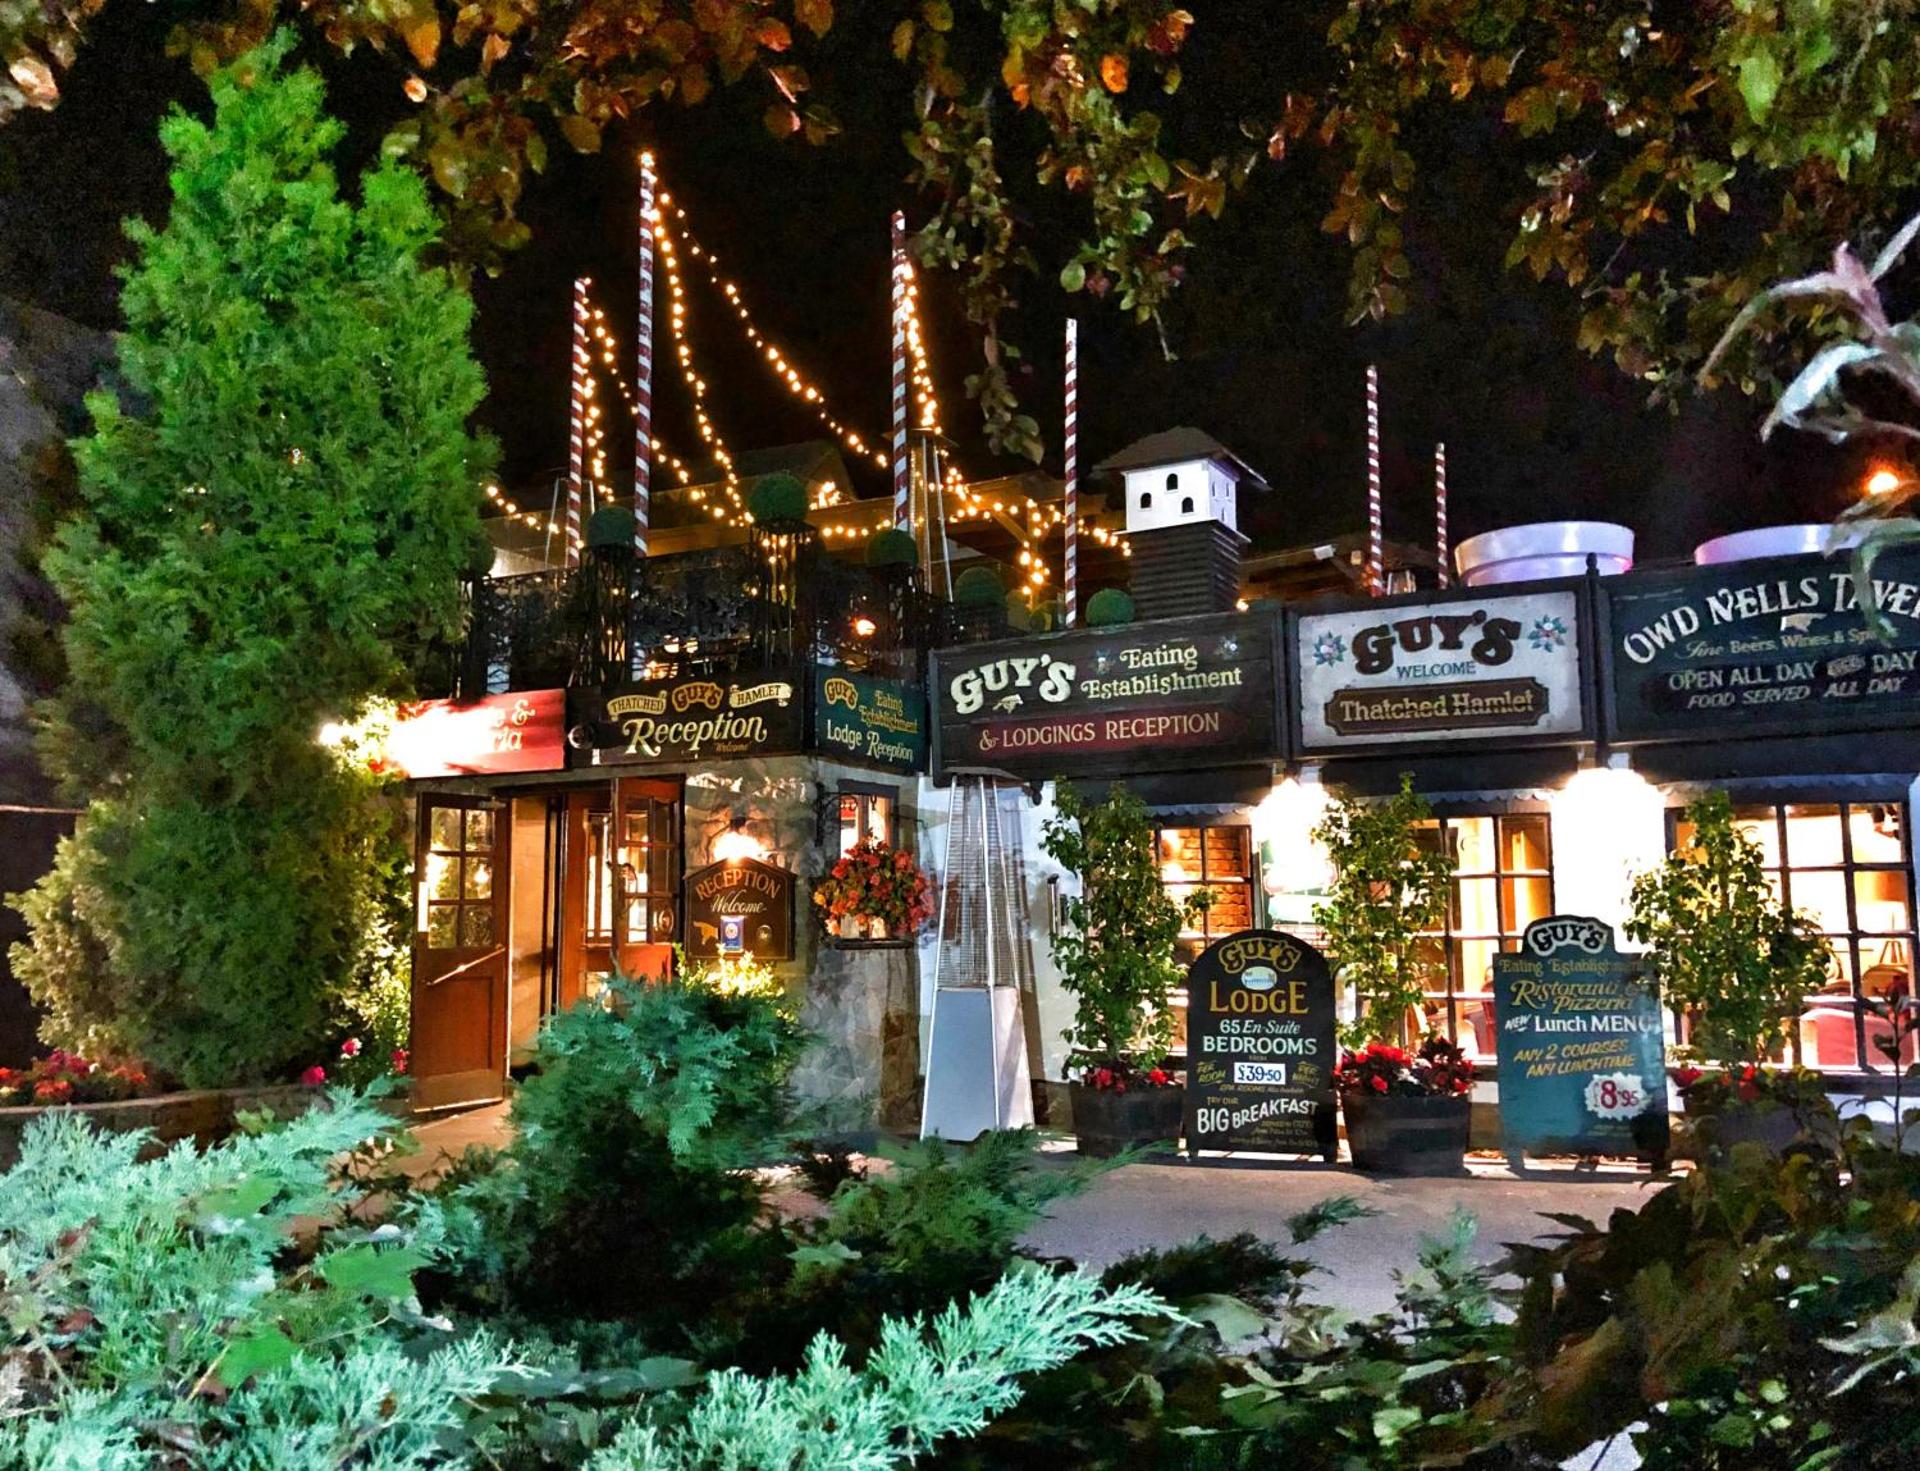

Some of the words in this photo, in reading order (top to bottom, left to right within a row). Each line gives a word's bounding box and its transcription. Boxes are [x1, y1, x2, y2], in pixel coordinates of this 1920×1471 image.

[1623, 605, 1701, 665] OWD
[1706, 575, 1820, 626] NELLS
[1829, 572, 1920, 620] TVE
[1352, 609, 1522, 675] GUY'S
[1833, 630, 1845, 644] &
[1119, 644, 1198, 671] Eating
[1396, 661, 1477, 680] WELCOME
[1668, 669, 1724, 691] OPEN
[1729, 666, 1771, 686] ALL
[1776, 660, 1818, 682] DAY
[1872, 650, 1918, 674] DAY
[611, 697, 664, 713] THATCHED
[673, 683, 723, 711] GUY'S
[737, 685, 781, 705] HAMLET
[950, 653, 1077, 714] GUY'S
[1080, 667, 1243, 700] Establishment
[1687, 691, 1736, 709] FOOD
[1741, 684, 1811, 704] SERVED
[1823, 680, 1861, 698] ALL
[1866, 675, 1908, 695] DAY
[511, 699, 536, 726] &
[1340, 695, 1448, 723] Thatched
[1451, 689, 1535, 717] Hamlet
[622, 711, 768, 757] Reception
[827, 719, 862, 750] Lodge
[866, 730, 914, 762] Reception
[979, 729, 999, 751] &
[1003, 722, 1096, 747] LODGINGS
[1105, 712, 1220, 740] RECEPTION
[695, 868, 781, 900] RECEPTION
[711, 889, 767, 914] Welcome
[1527, 920, 1607, 957] GUY'S
[1219, 937, 1302, 974] GUY'S
[1499, 957, 1544, 977] Eating
[1210, 980, 1310, 1014] LODGE
[1220, 1019, 1240, 1034] 65
[1505, 1014, 1532, 1031] NEW
[1534, 1014, 1588, 1032] Lunch
[1590, 1014, 1651, 1033] MENU
[1202, 1035, 1318, 1055] BEDROOMS
[1513, 1048, 1544, 1062] ANY
[1545, 1043, 1559, 1060] 2
[1562, 1038, 1630, 1058] COURSES
[1526, 1061, 1557, 1079] ANY
[1557, 1054, 1636, 1074] LUNCHTIME
[1197, 1107, 1229, 1134] BIG
[1232, 1098, 1319, 1129] BREAKFAST
